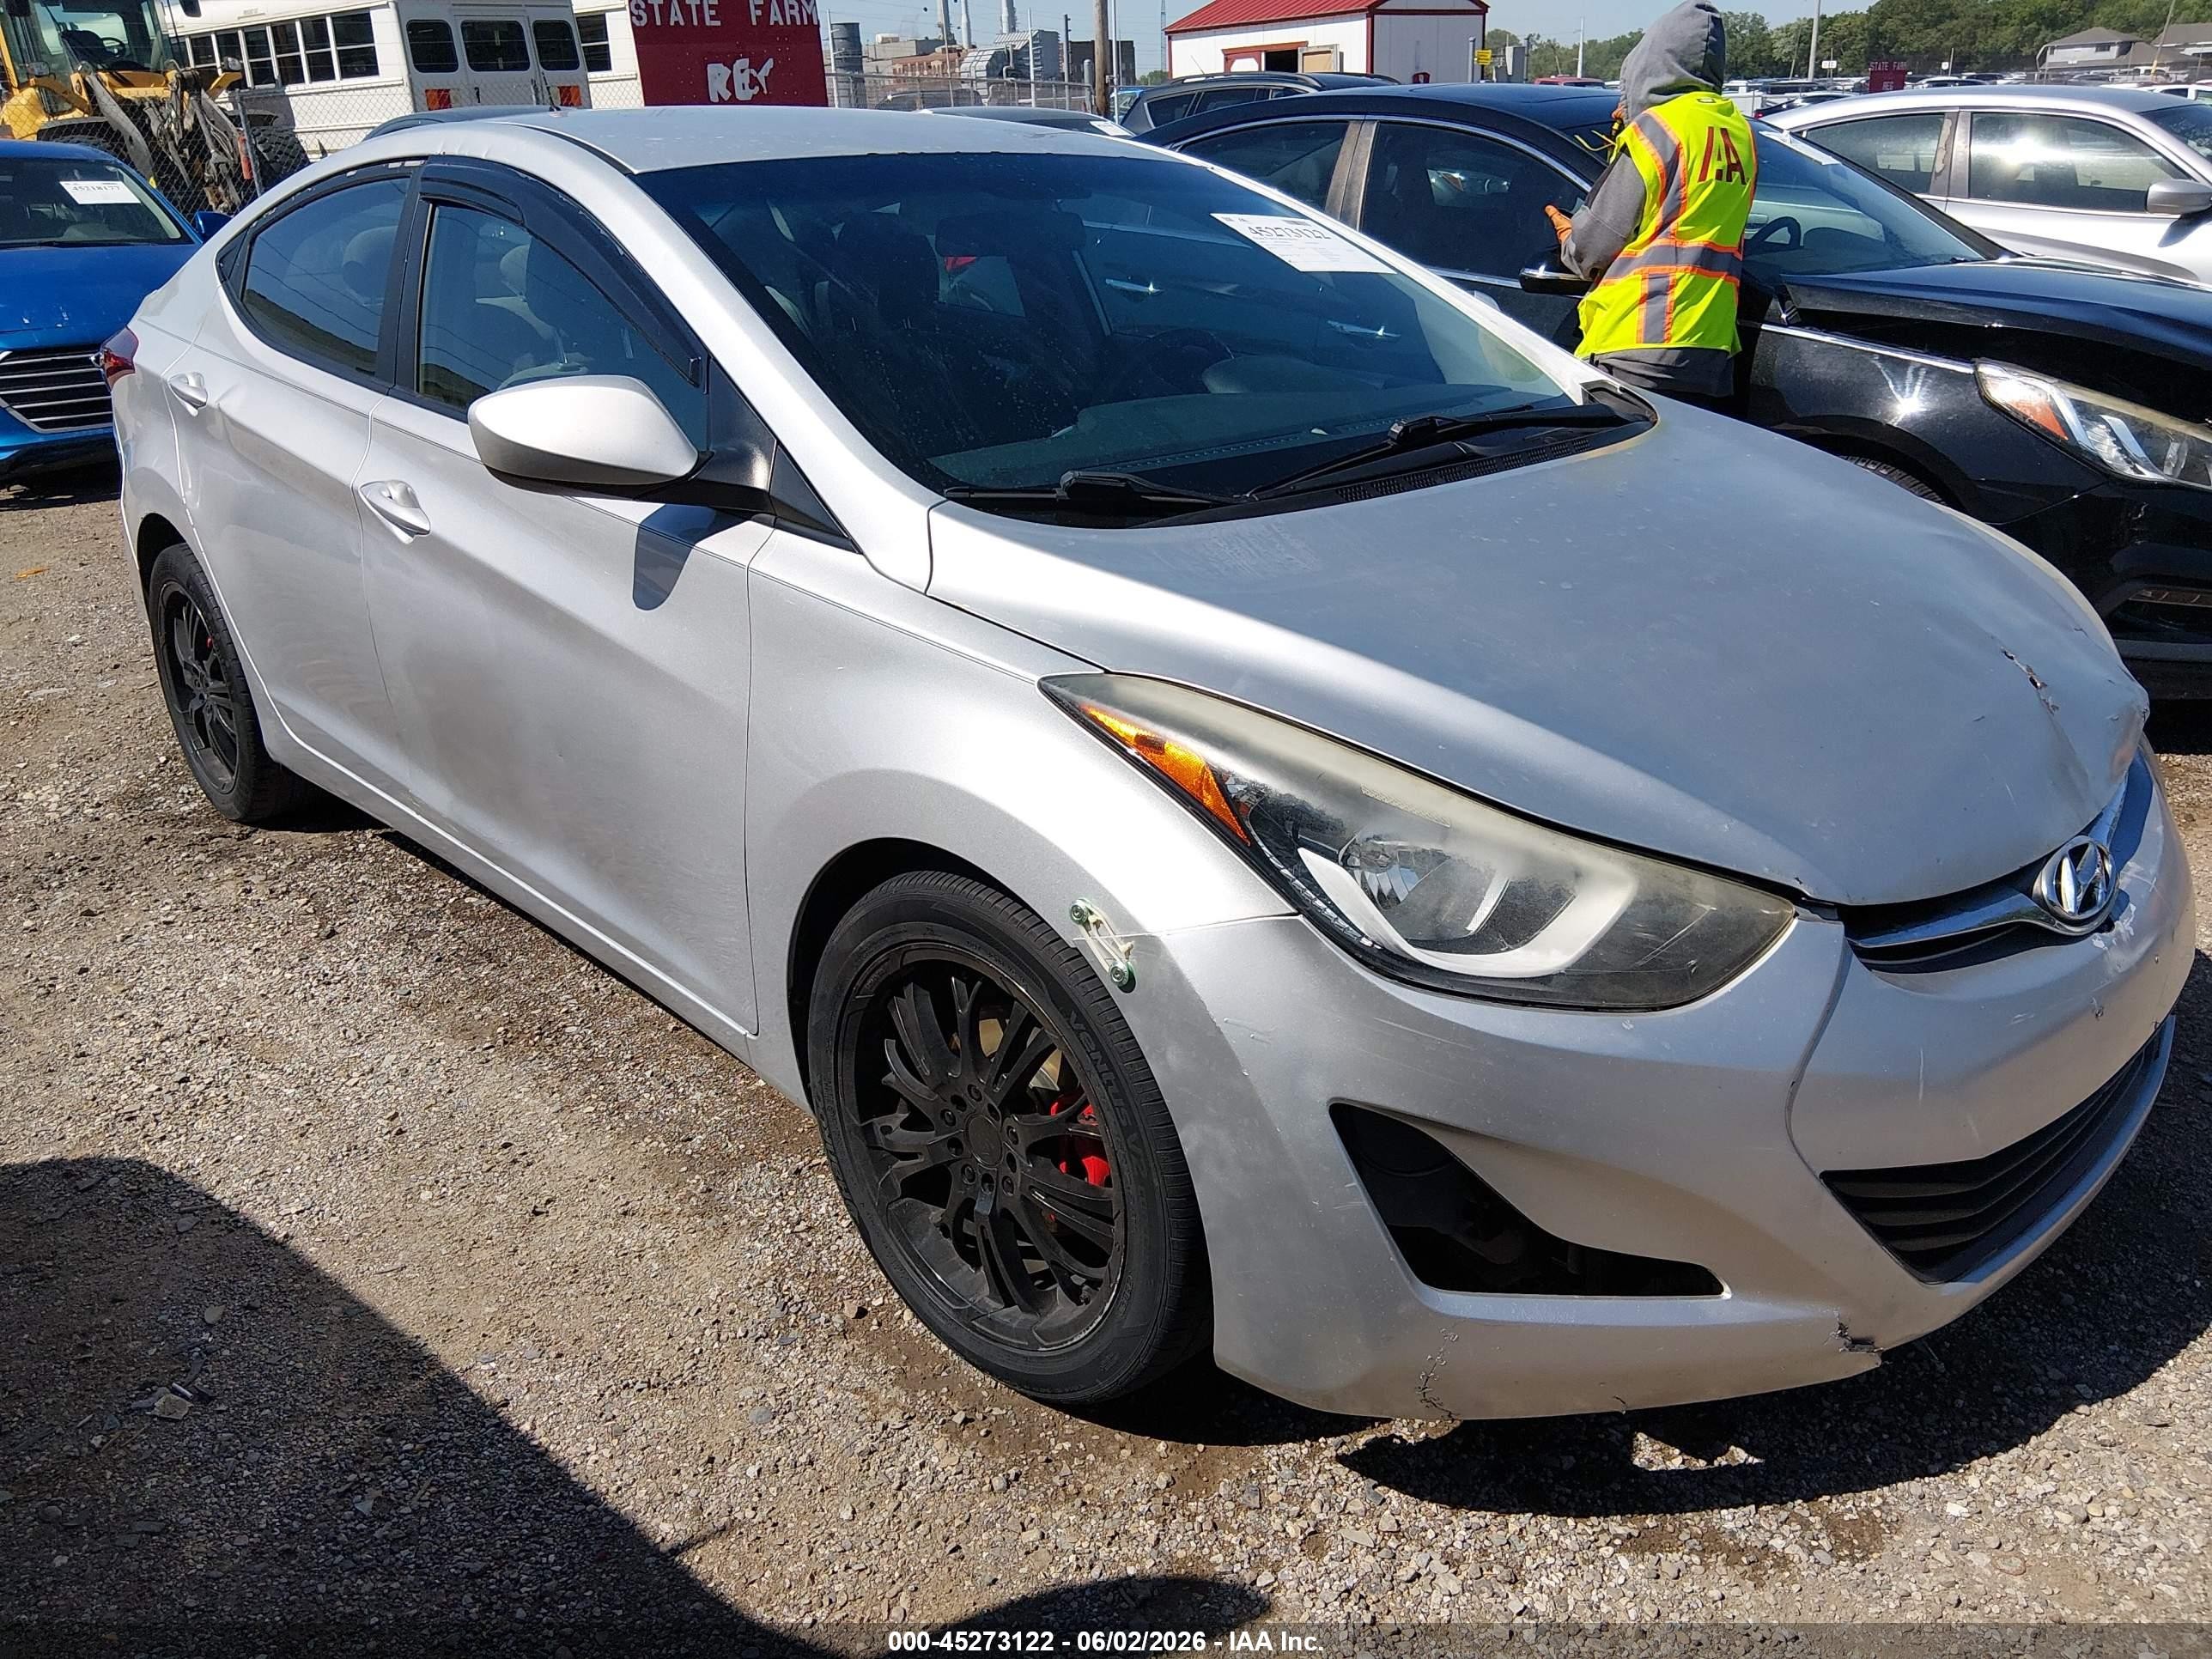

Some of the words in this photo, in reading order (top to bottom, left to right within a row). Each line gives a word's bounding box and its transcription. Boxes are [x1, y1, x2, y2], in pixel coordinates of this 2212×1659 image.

[630, 0, 721, 27] STATE
[750, 0, 818, 26] FARM
[1248, 226, 1332, 240] 45273122
